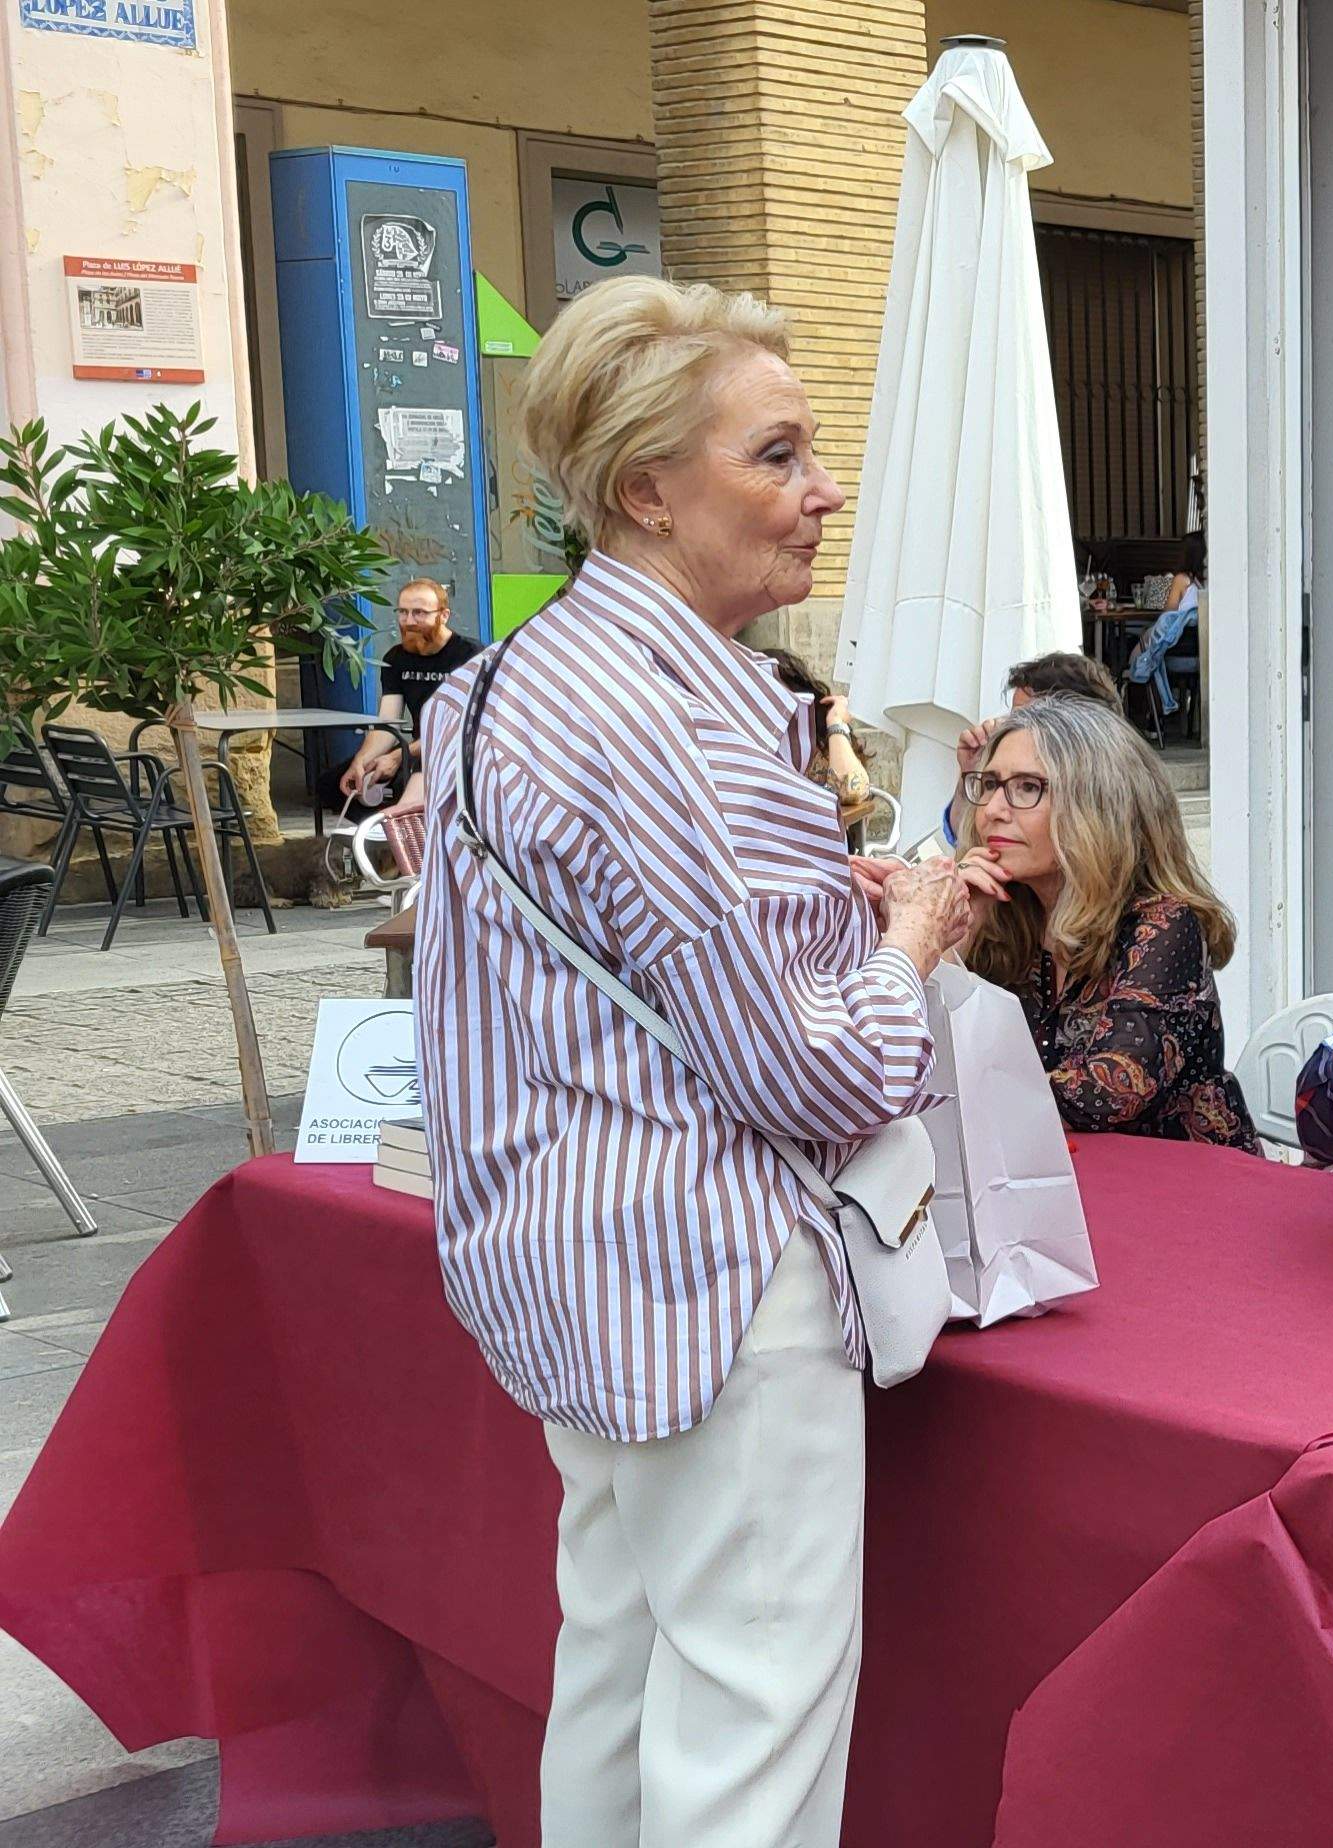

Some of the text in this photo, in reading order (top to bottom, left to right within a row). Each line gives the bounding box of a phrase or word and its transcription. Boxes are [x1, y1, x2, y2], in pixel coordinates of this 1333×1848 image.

[114, 262, 131, 271] LUIS
[307, 1133, 381, 1145] DE LIBRER
